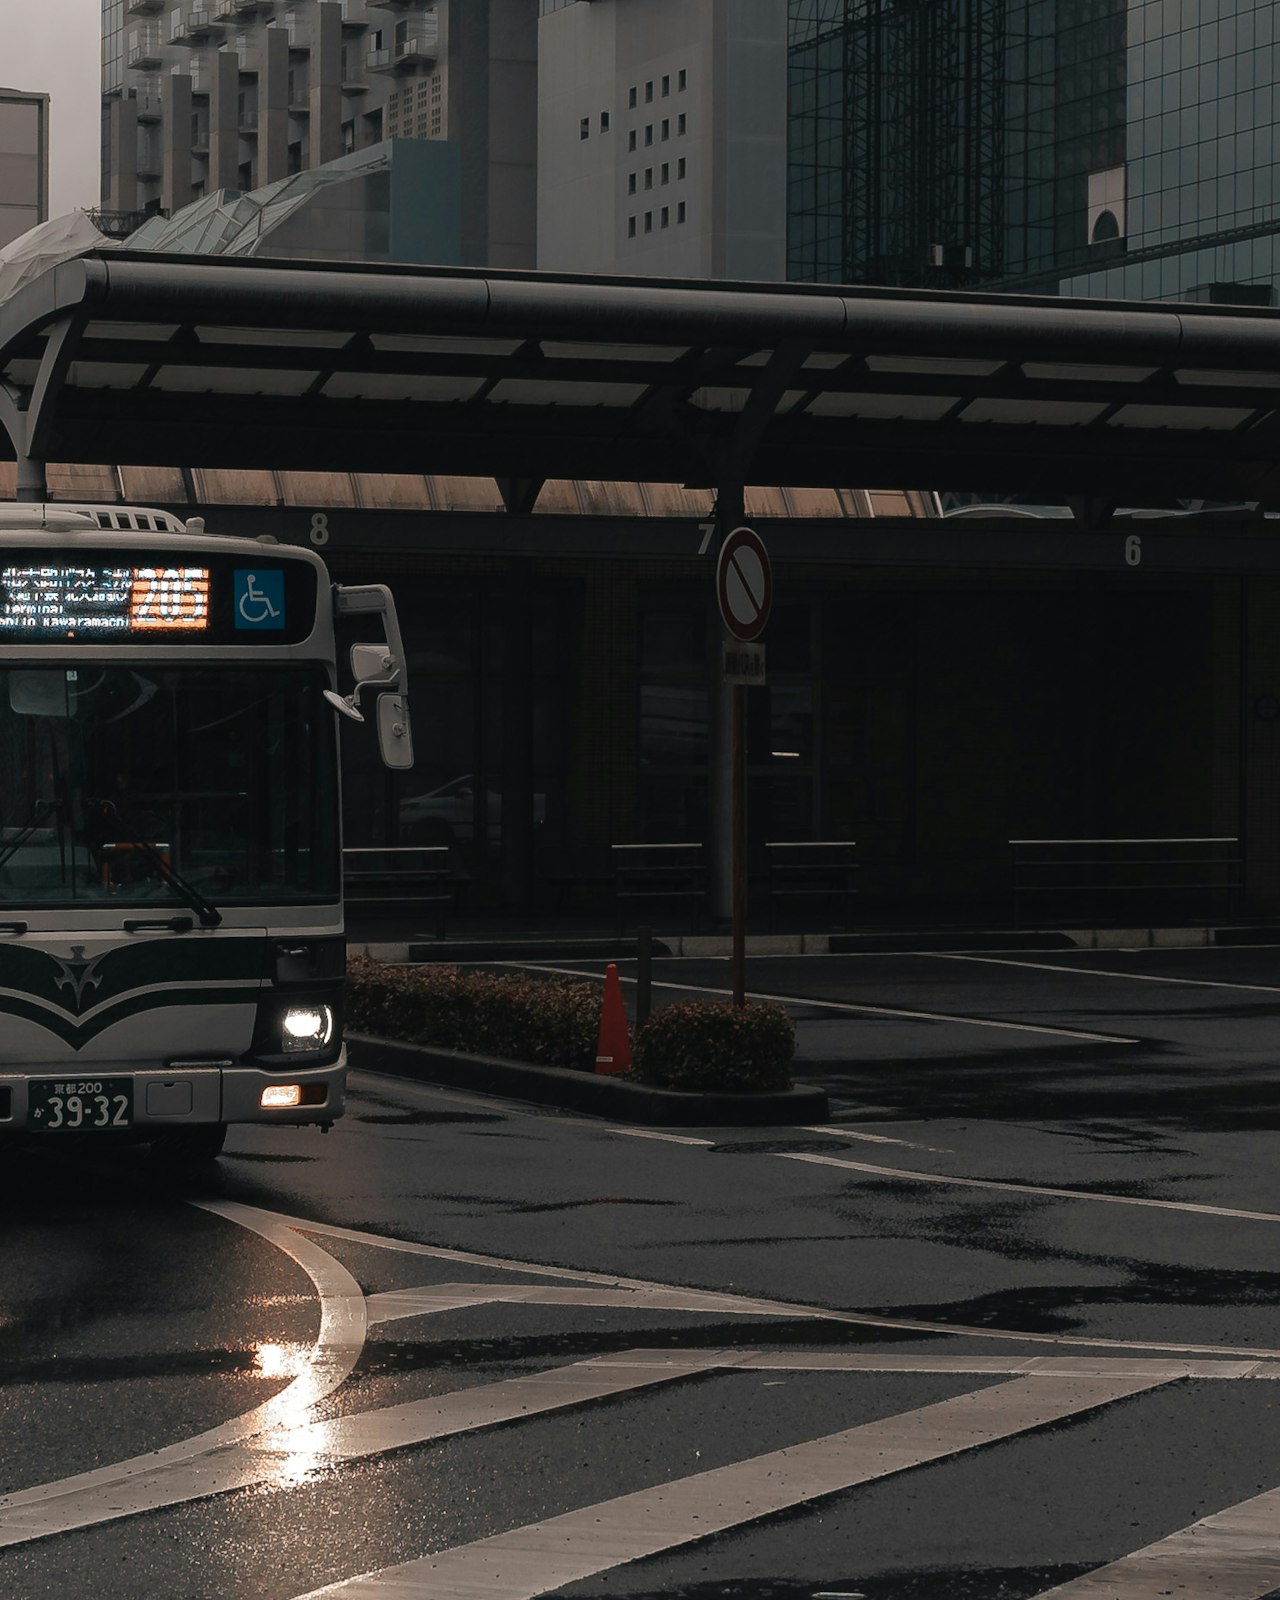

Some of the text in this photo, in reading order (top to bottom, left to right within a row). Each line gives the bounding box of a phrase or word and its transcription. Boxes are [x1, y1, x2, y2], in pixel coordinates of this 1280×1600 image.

[310, 513, 329, 545] 8
[698, 524, 715, 554] 7
[1125, 536, 1141, 566] 6
[47, 1094, 129, 1128] 39-32
